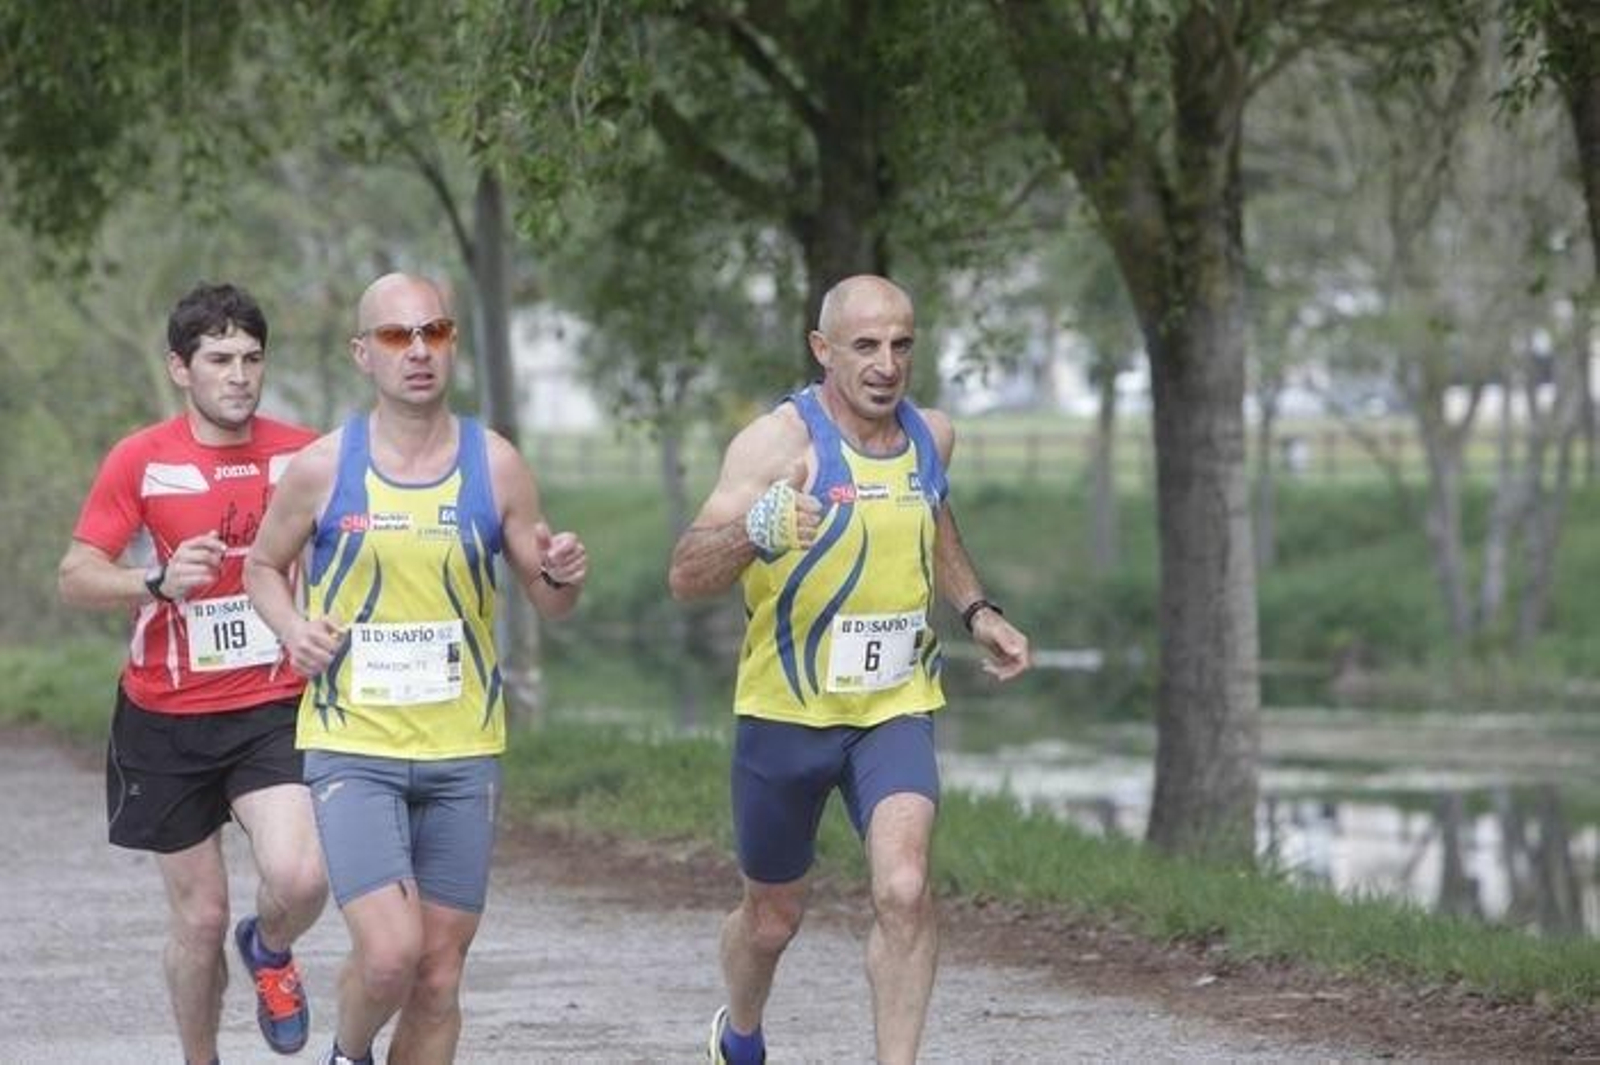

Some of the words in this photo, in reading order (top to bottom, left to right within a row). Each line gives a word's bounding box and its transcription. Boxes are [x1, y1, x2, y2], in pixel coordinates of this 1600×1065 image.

[213, 620, 247, 651] 119
[361, 628, 371, 642] II
[865, 640, 882, 672] 6
